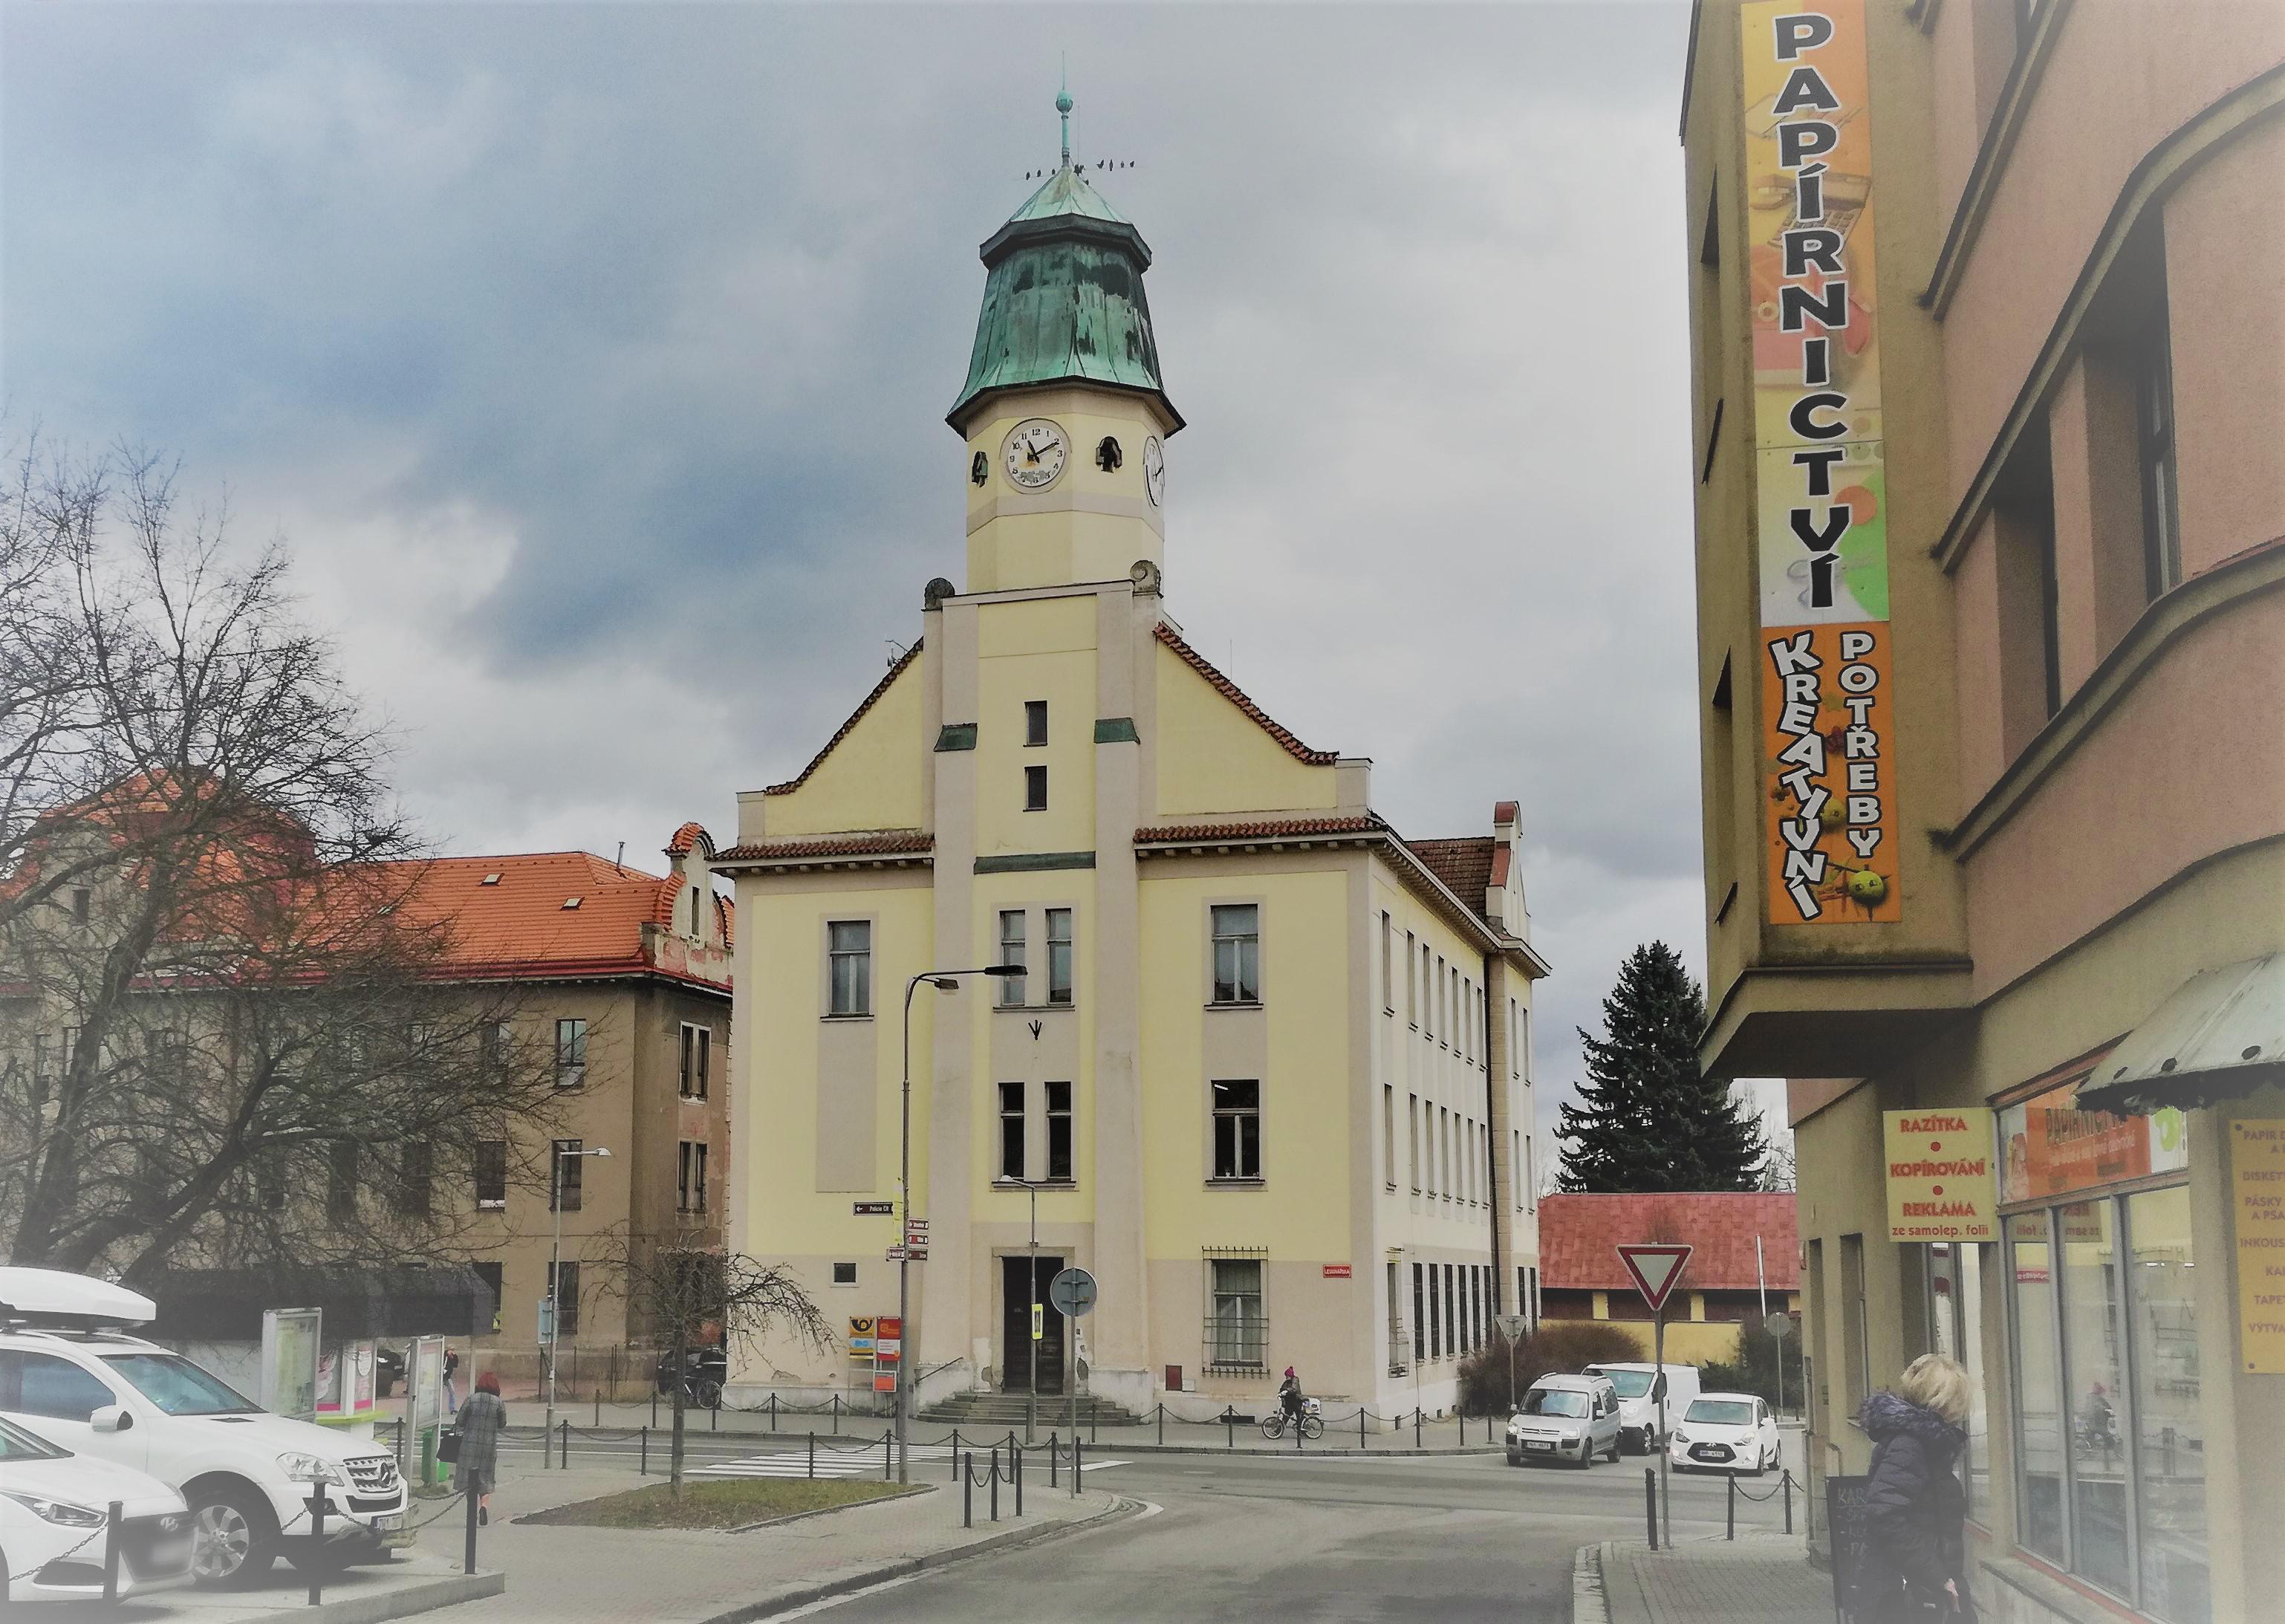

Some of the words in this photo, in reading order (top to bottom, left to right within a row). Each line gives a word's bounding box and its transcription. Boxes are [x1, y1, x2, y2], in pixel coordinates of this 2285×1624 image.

[1773, 13, 1850, 608] PAPÍRNICTVÍ
[1032, 428, 1040, 436] 12
[1839, 631, 1882, 859] POTŘEBY
[1769, 630, 1829, 920] KREATIVNÍ
[1899, 1114, 1968, 1133] RAZÍTKA
[1890, 1157, 1986, 1178] KOPÍROVÁNÍ
[2243, 1171, 2285, 1181] DISKET
[1902, 1201, 1977, 1217] REKLAMA
[1892, 1227, 1905, 1235] ze
[1908, 1224, 1963, 1238] samolep.
